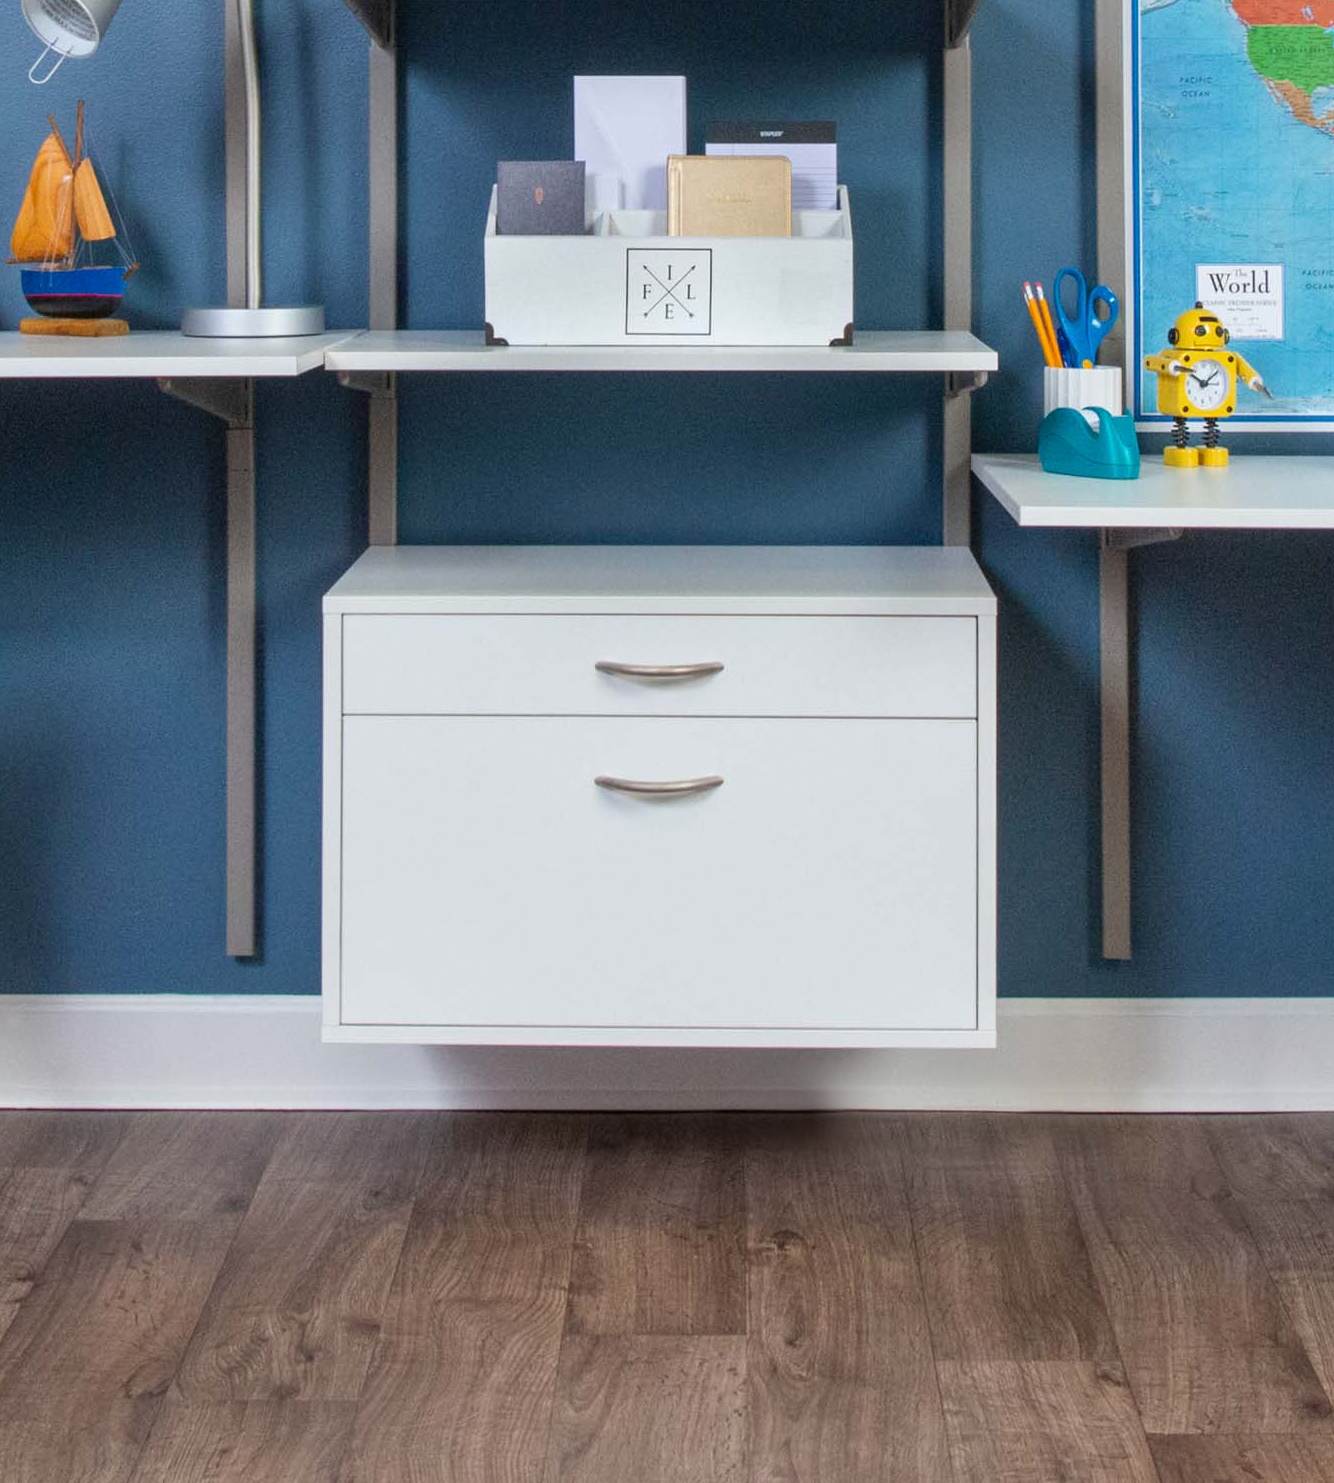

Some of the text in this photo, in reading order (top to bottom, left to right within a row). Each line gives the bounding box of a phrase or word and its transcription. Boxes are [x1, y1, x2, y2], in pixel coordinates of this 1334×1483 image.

[1178, 76, 1213, 85] PACIFIC
[1180, 89, 1211, 98] OCEAN
[1206, 269, 1272, 295] World
